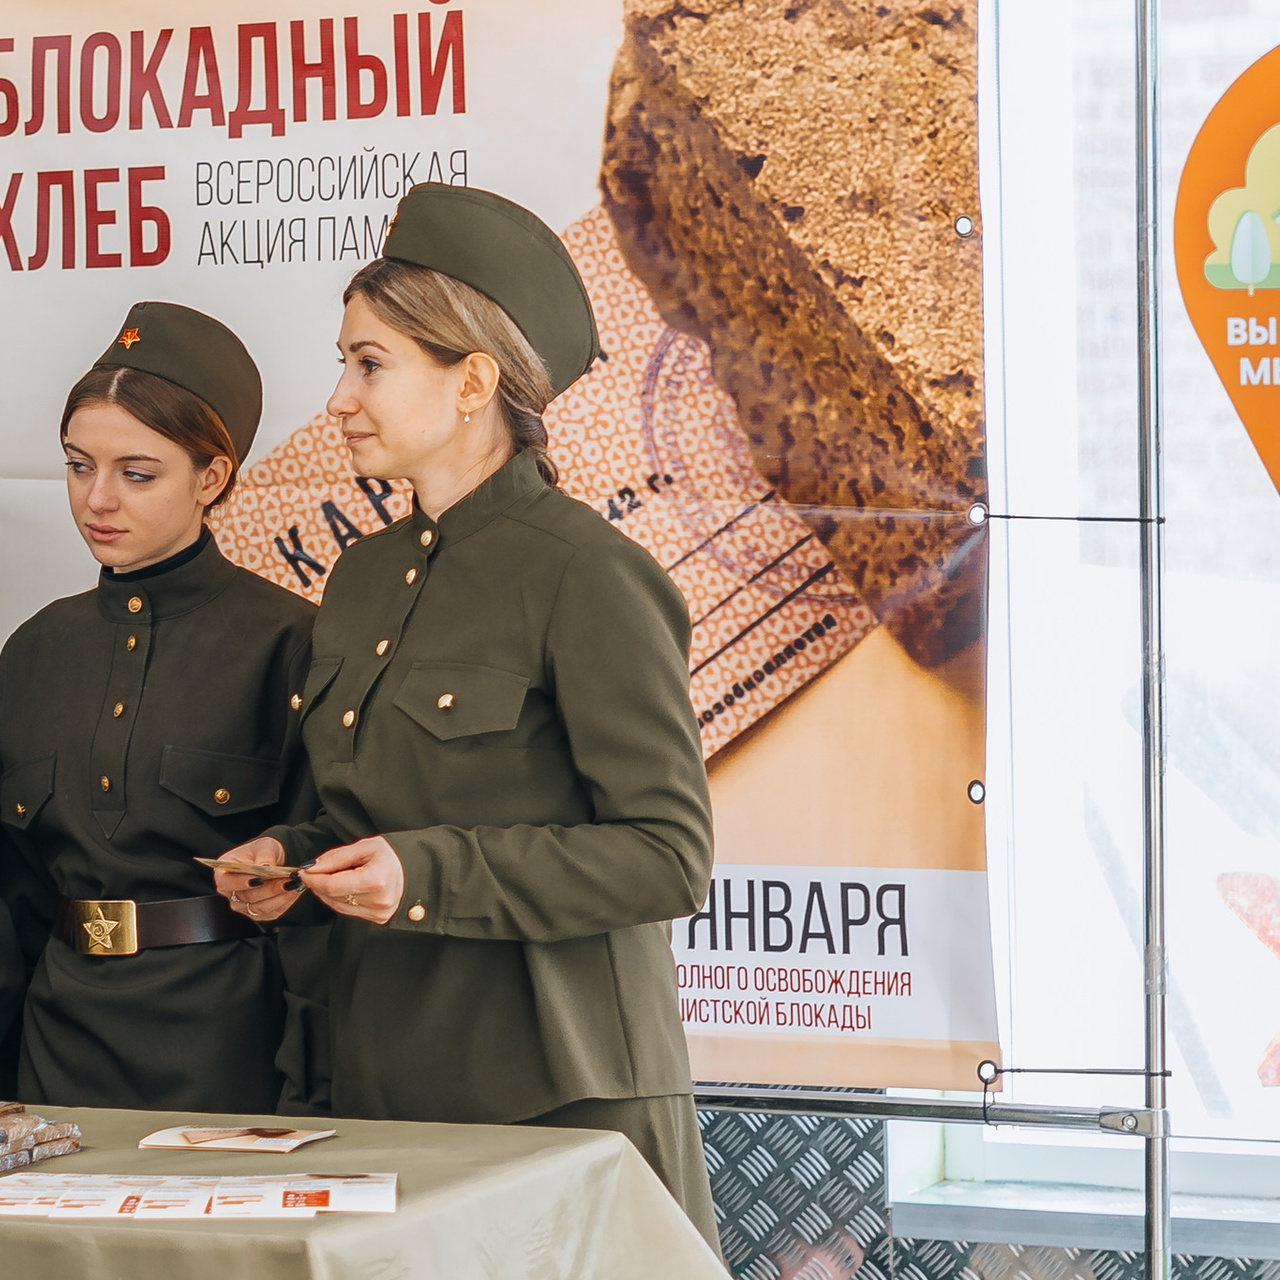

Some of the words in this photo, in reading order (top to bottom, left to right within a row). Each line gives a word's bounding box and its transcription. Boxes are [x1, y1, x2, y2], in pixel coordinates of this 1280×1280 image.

[196, 146, 468, 207] ВСЕРОССИЙСКАЯ
[197, 217, 307, 269] АКЦИЯ
[317, 214, 389, 262] ПАМ
[1226, 316, 1278, 347] ВЫ
[607, 486, 643, 521] 42
[274, 476, 394, 589] КАР
[687, 878, 909, 957] ЯНВАРЯ
[676, 963, 749, 991] ОЛНОГО
[754, 966, 912, 998] ОСВОБОЖДЕНИЯ
[681, 995, 770, 1026] ИСТСКОЙ
[775, 1001, 873, 1032] БЛОКАДЫ
